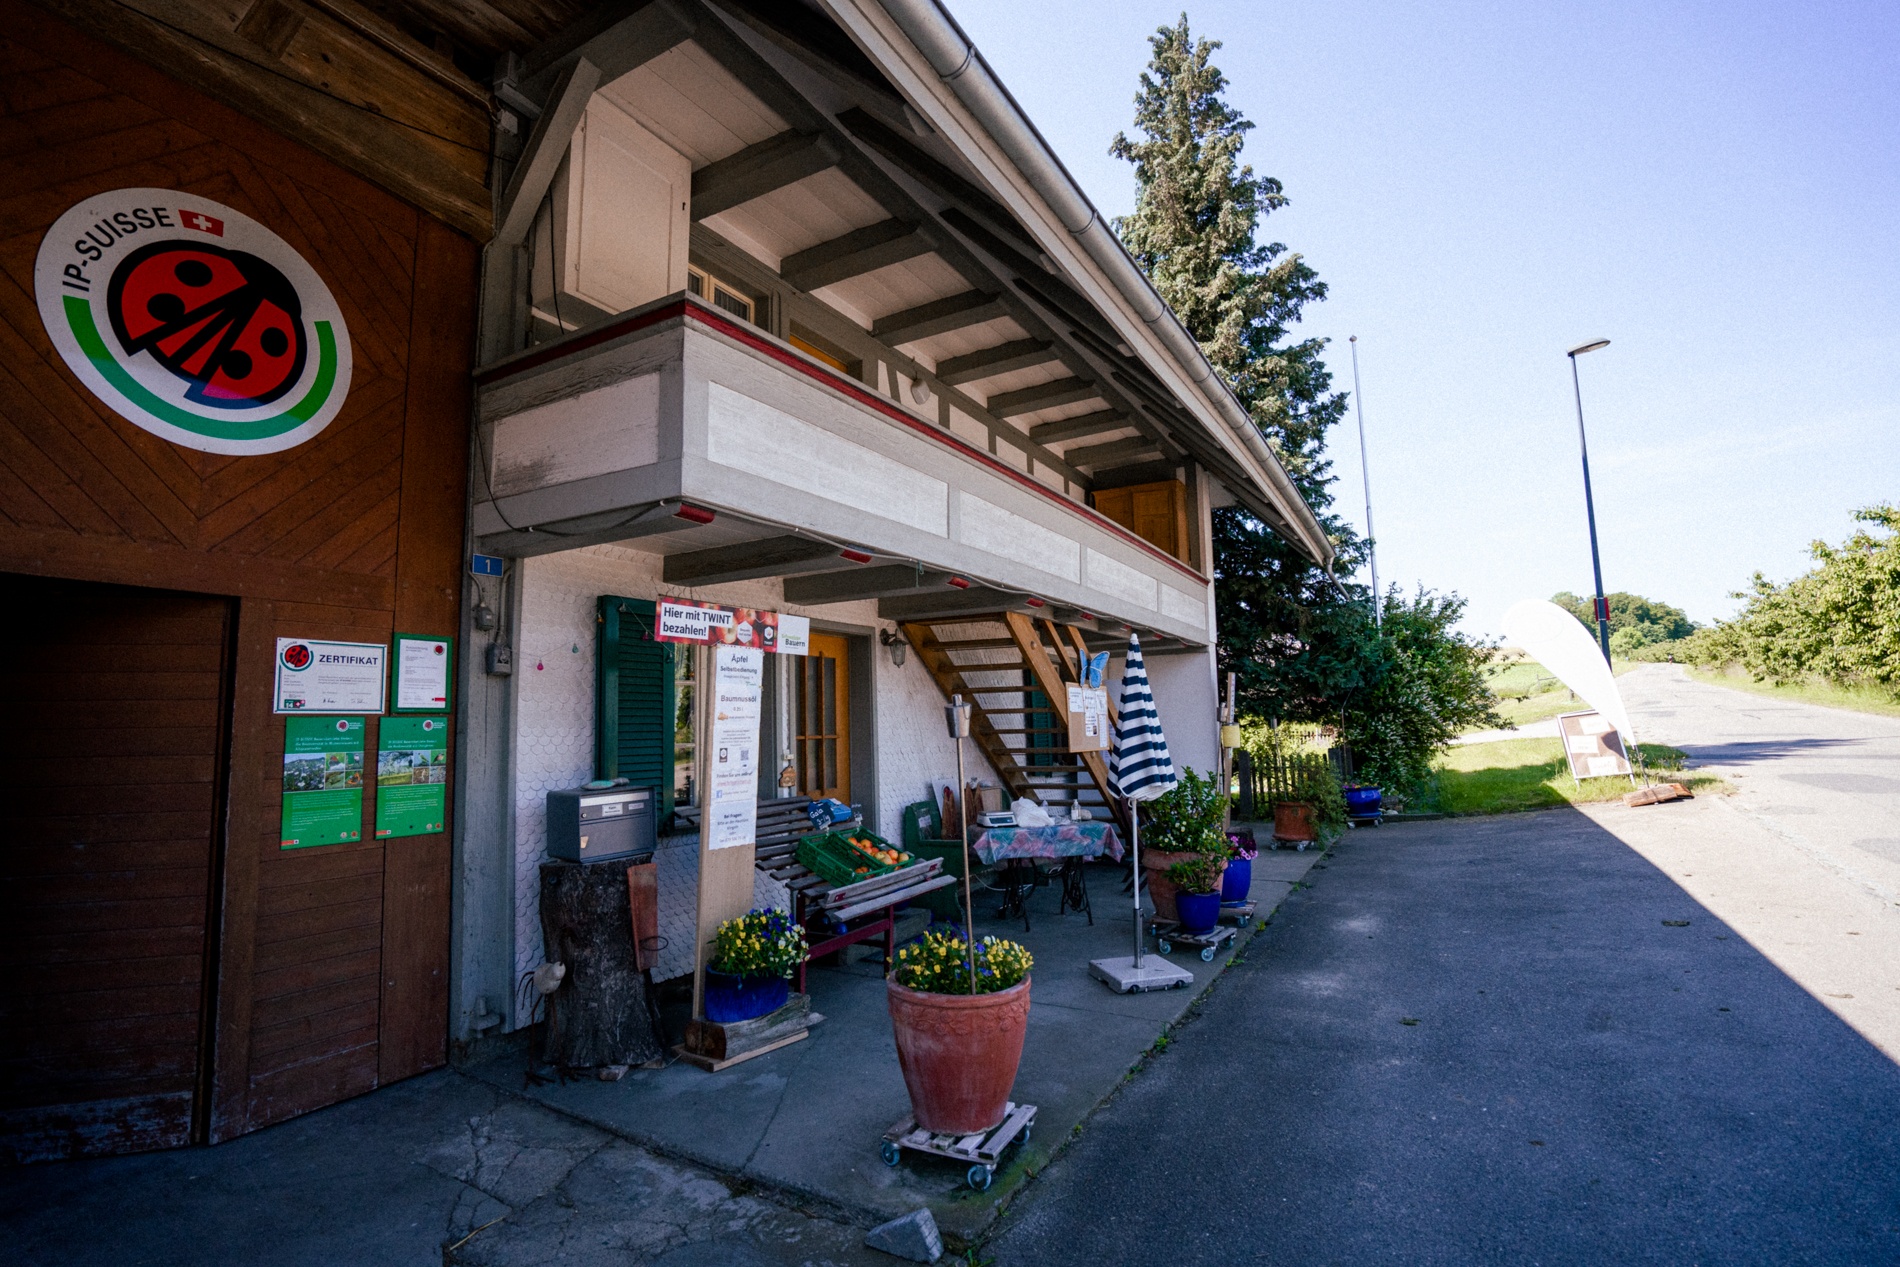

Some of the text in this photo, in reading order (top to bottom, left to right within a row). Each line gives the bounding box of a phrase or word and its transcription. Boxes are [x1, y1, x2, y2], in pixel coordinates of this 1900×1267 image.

[62, 207, 175, 292] IP-SUISSE
[485, 559, 491, 573] 1
[663, 606, 731, 625] Hier mit TWINT
[662, 621, 707, 637] bezahlen!
[785, 638, 806, 647] Bauern
[318, 654, 379, 665] ZERTIFIKAT
[731, 653, 749, 663] Äpfel
[720, 665, 757, 674] Selbstbedienung
[809, 808, 824, 819] Gala
